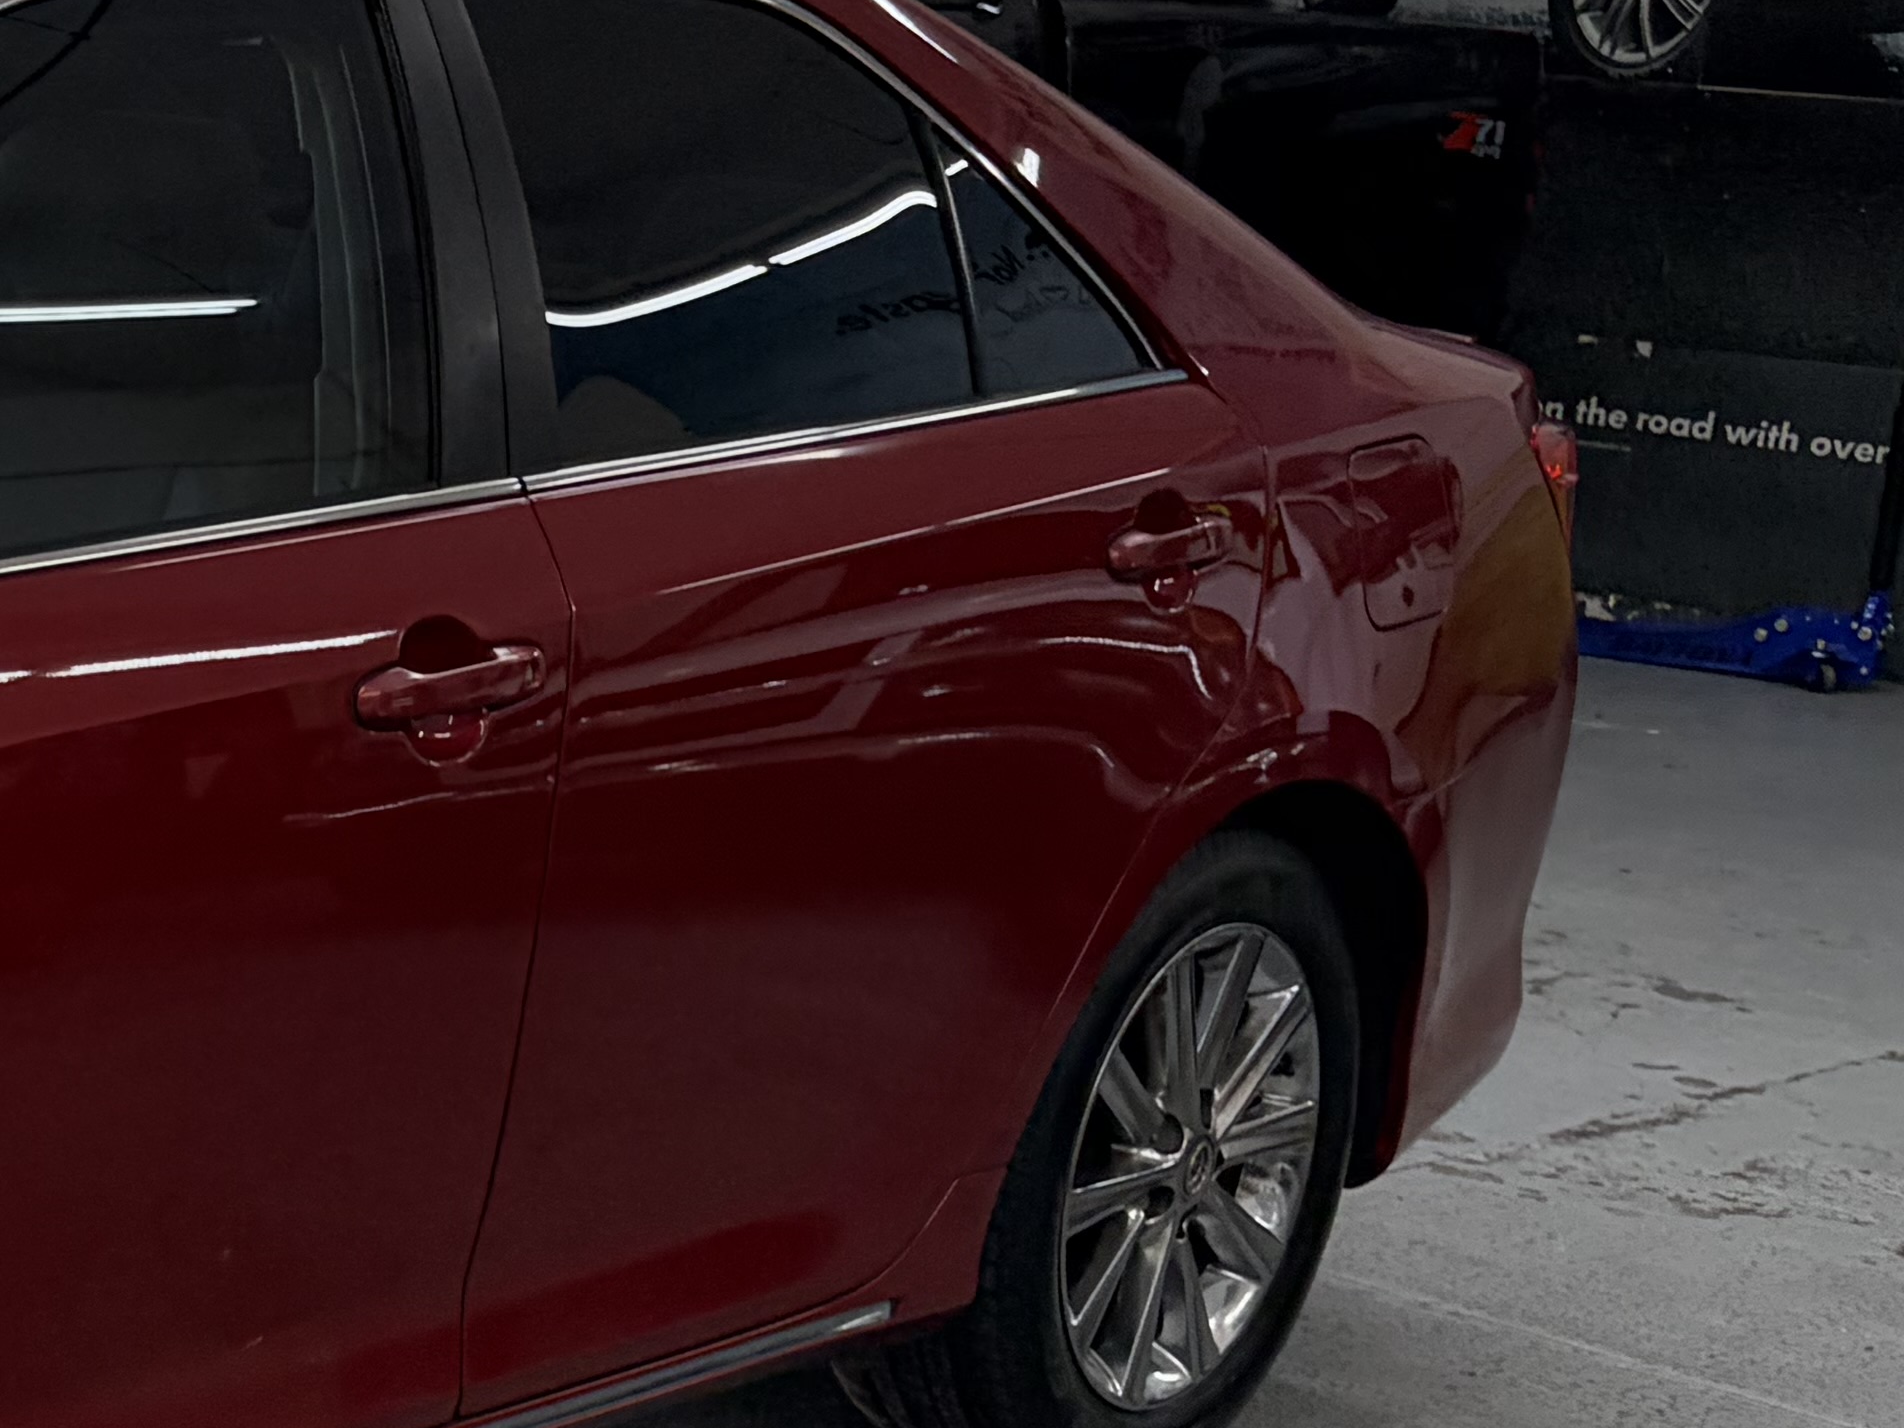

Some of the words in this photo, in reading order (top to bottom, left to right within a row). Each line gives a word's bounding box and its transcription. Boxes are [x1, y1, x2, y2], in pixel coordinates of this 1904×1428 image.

[1437, 111, 1506, 149] Z71
[1539, 400, 1563, 420] n
[1576, 396, 1628, 429] the
[1635, 410, 1716, 441] road
[1725, 420, 1799, 453] with
[1809, 436, 1891, 465] over
